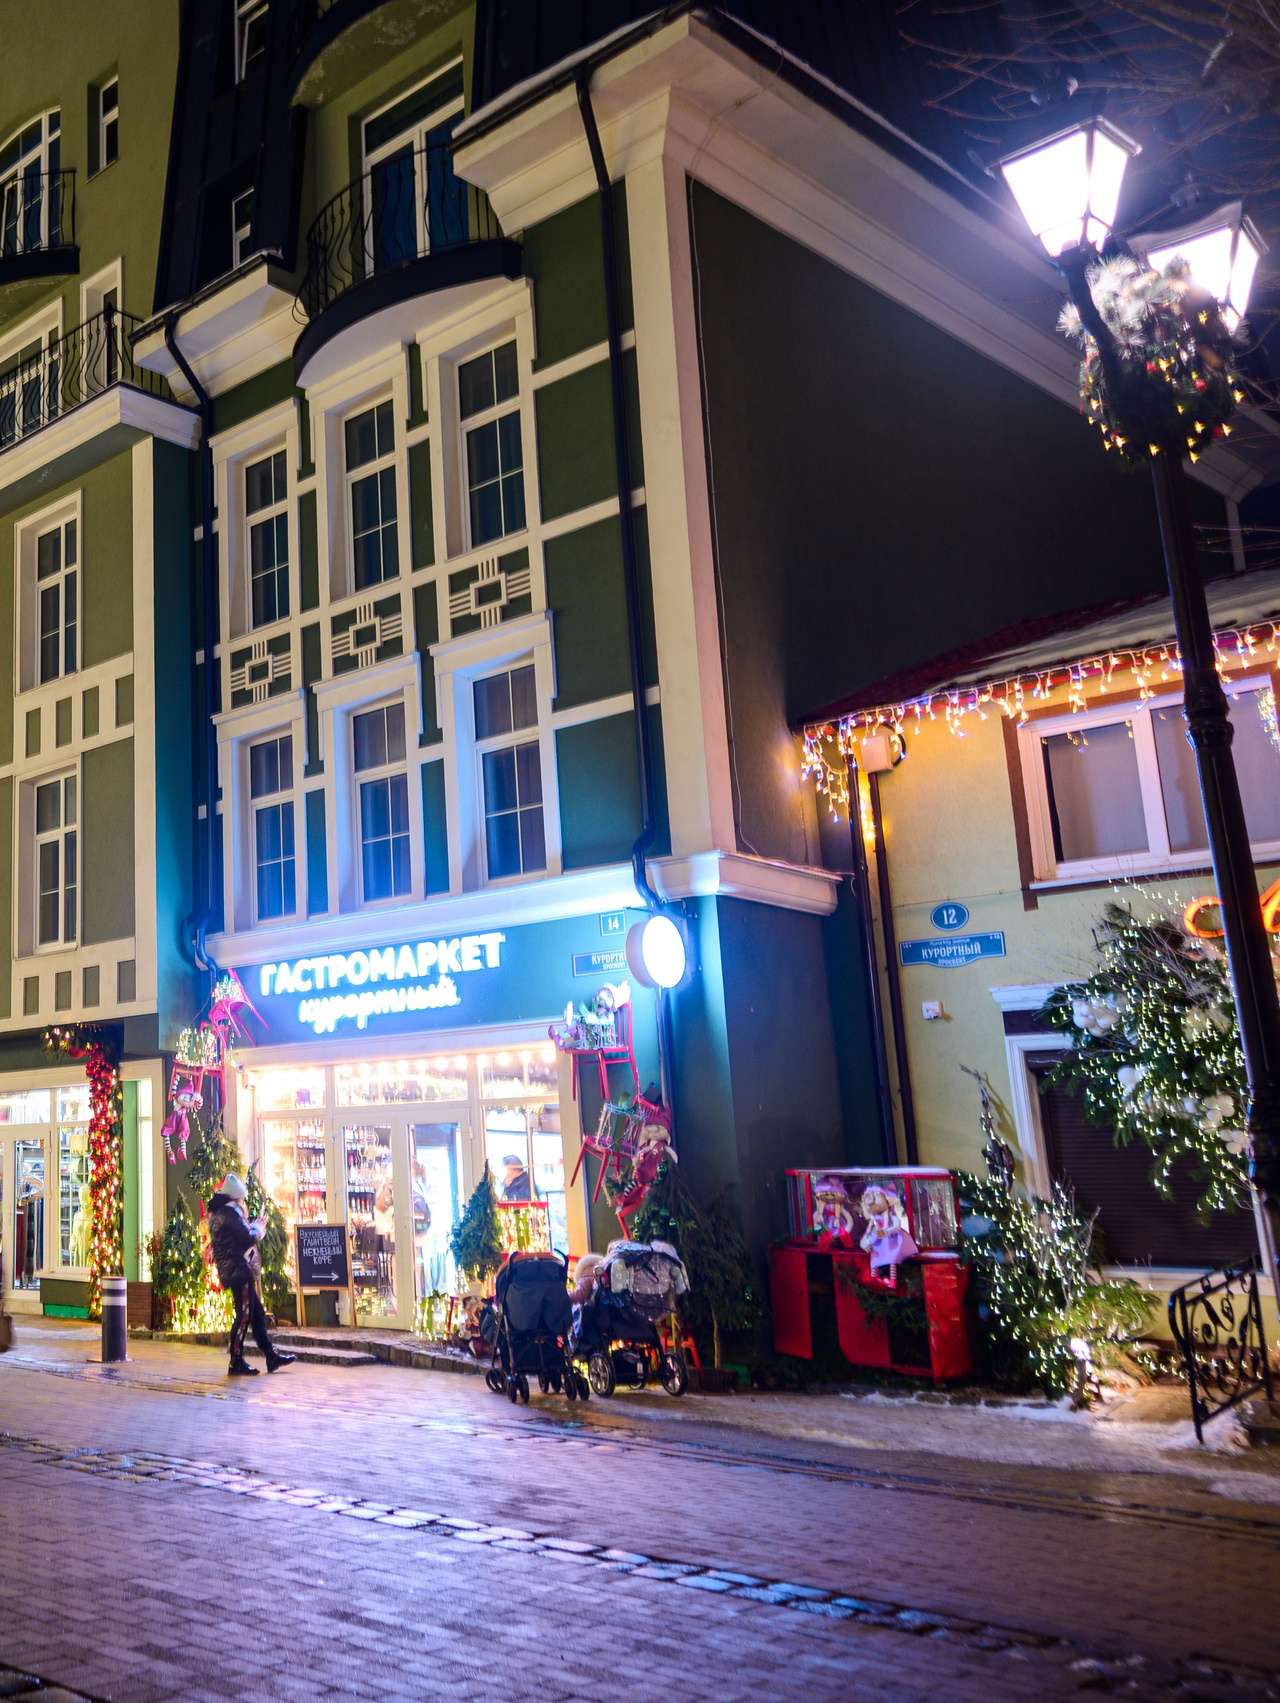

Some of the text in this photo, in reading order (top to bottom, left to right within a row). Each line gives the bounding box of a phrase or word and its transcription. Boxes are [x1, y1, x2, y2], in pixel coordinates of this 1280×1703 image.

[608, 916, 619, 931] 14
[943, 908, 958, 925] 12
[922, 942, 981, 959] КУРОРТНЫЙ
[260, 931, 506, 997] ГАСТРОМАРКЕТ
[592, 952, 626, 965] КУРОРТН
[603, 962, 625, 970] ПРОСПЕКТ
[938, 957, 966, 965] ПРОСПЕКТ
[299, 973, 462, 1035] курортный
[313, 1256, 332, 1265] КОФЕ
